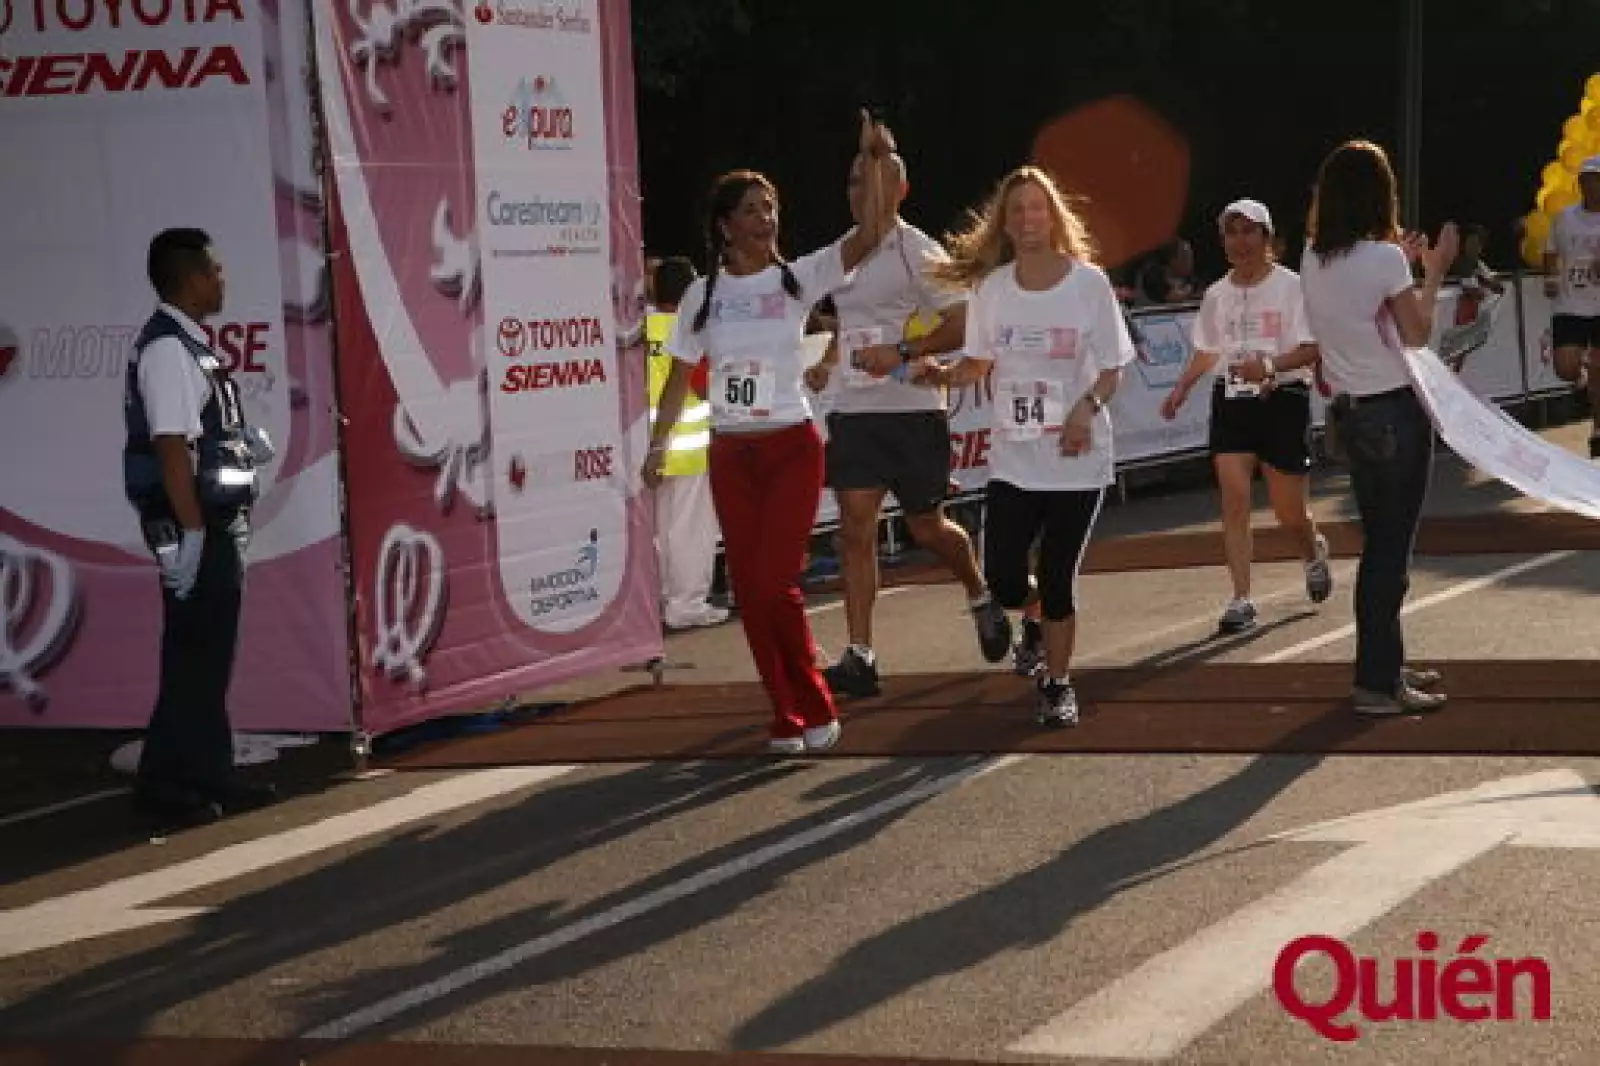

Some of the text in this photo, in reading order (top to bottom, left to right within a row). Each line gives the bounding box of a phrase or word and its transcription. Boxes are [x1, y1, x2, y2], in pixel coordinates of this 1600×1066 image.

[527, 318, 604, 349] TOYOTA
[500, 359, 606, 393] SIENNA
[725, 377, 757, 406] 50
[1012, 397, 1045, 425] 64
[575, 446, 612, 481] ROSE
[949, 428, 991, 470] SIE
